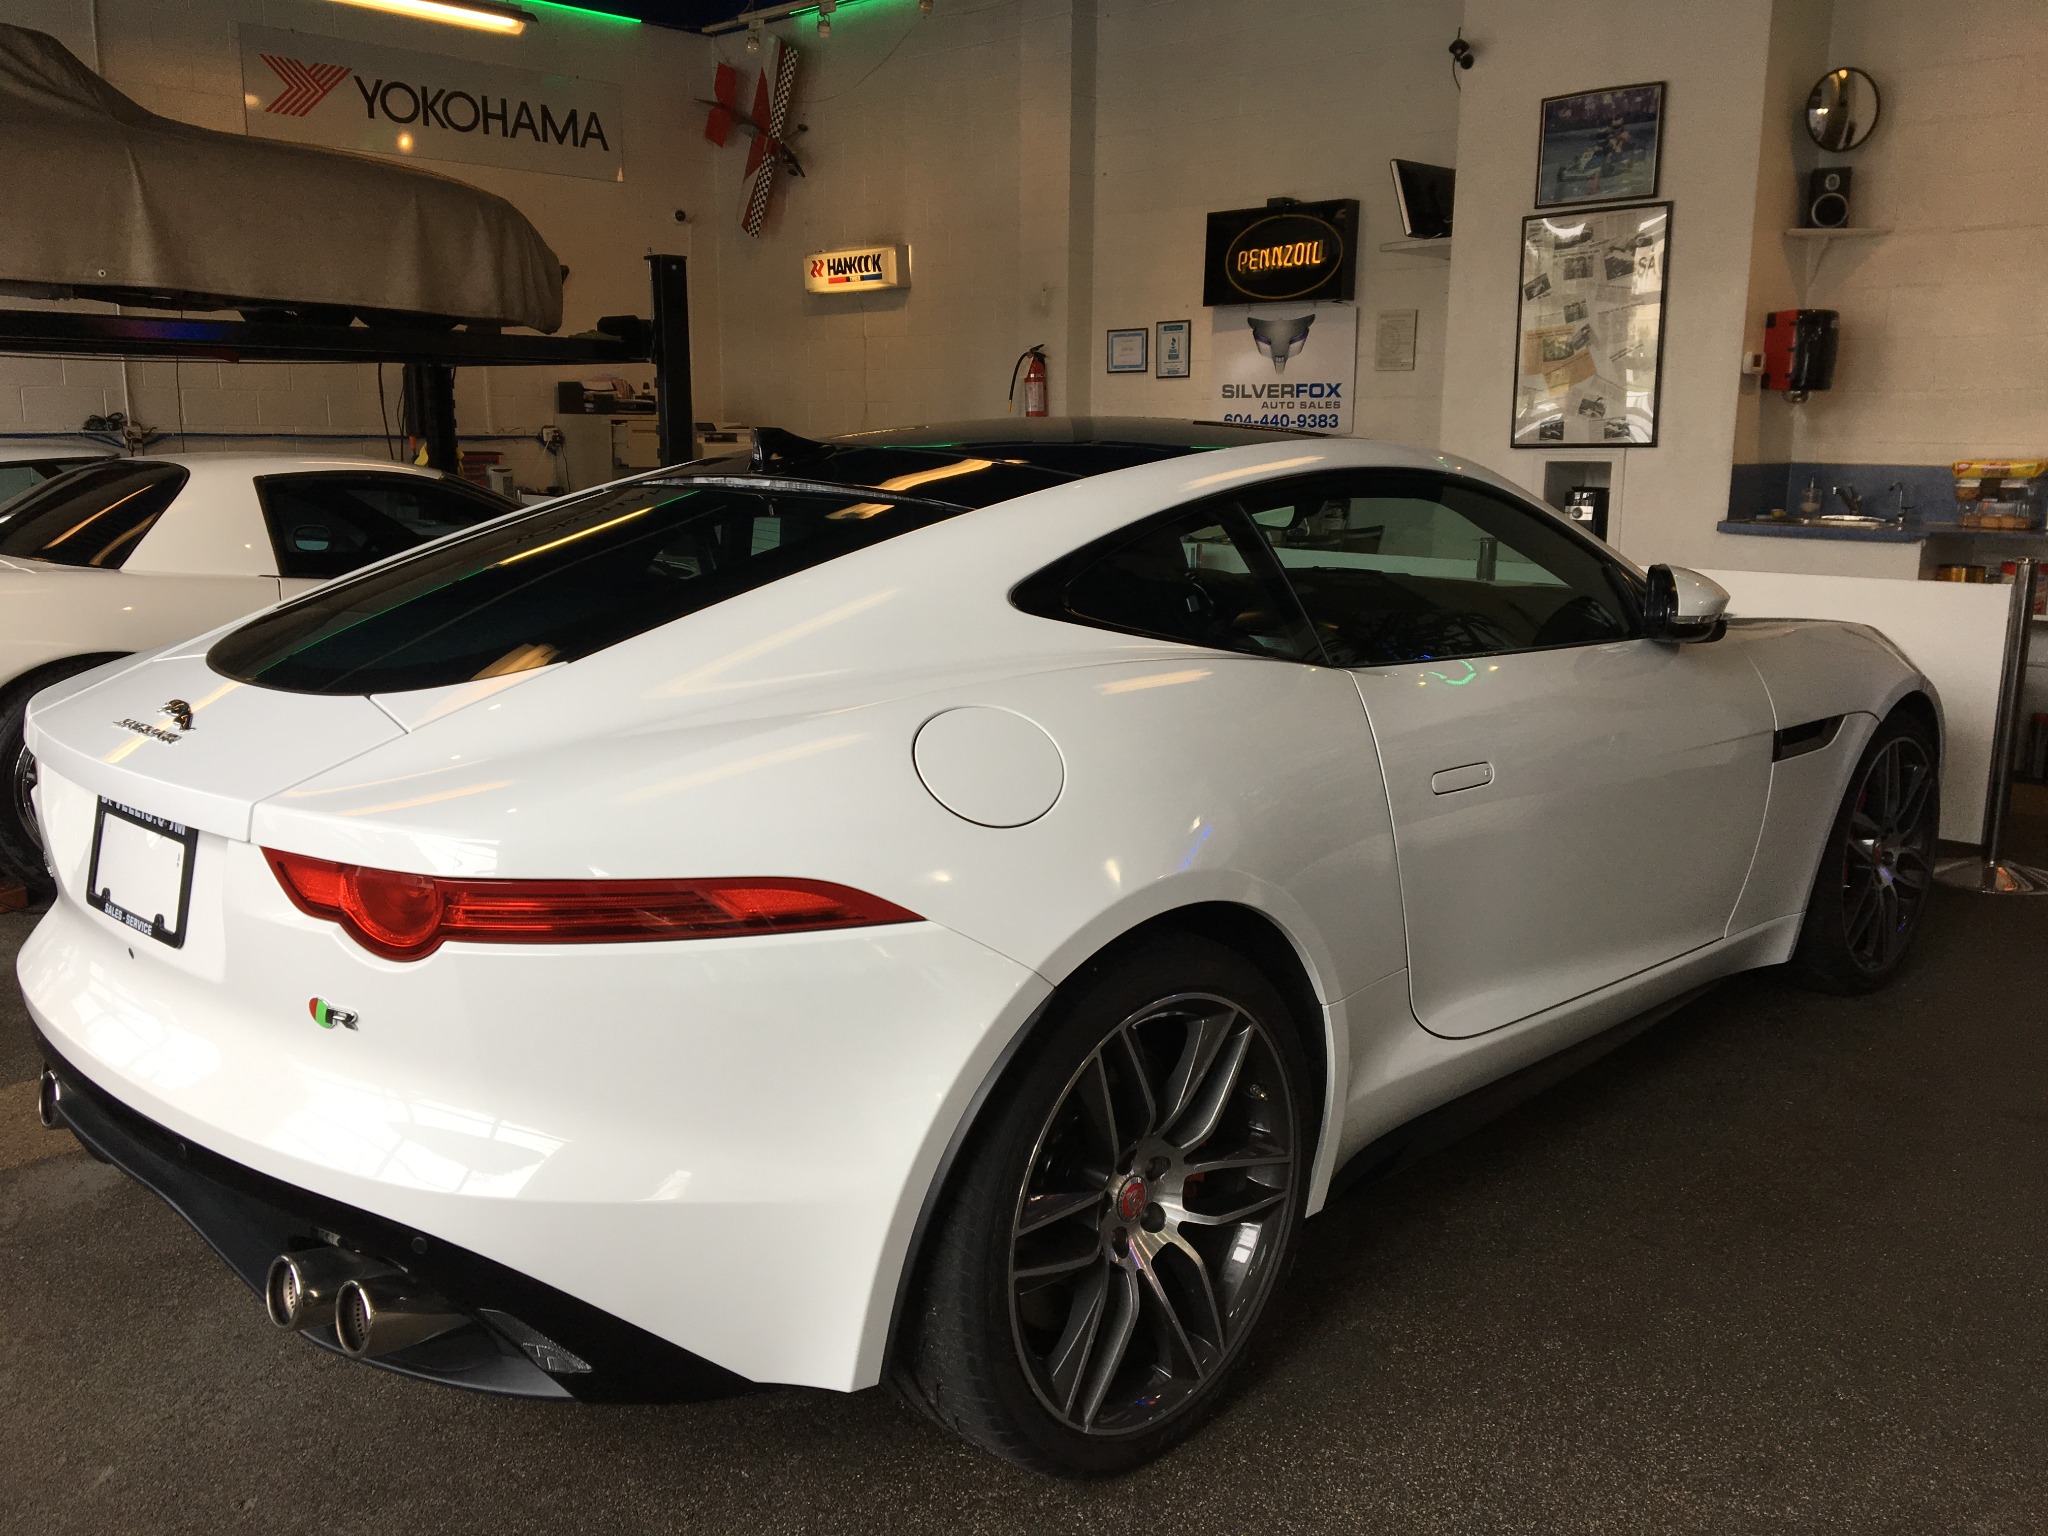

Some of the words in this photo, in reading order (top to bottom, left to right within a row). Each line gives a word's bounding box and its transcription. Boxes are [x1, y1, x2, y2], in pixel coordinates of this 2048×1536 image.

[354, 75, 609, 151] YOKOHAMA
[827, 253, 882, 276] HANKOOK
[1237, 240, 1325, 274] PENNZOIL
[1221, 382, 1342, 399] SILVERFOX
[1261, 400, 1295, 410] AUTO
[1299, 400, 1341, 410] SALES
[1223, 412, 1339, 429] 604-440-9383
